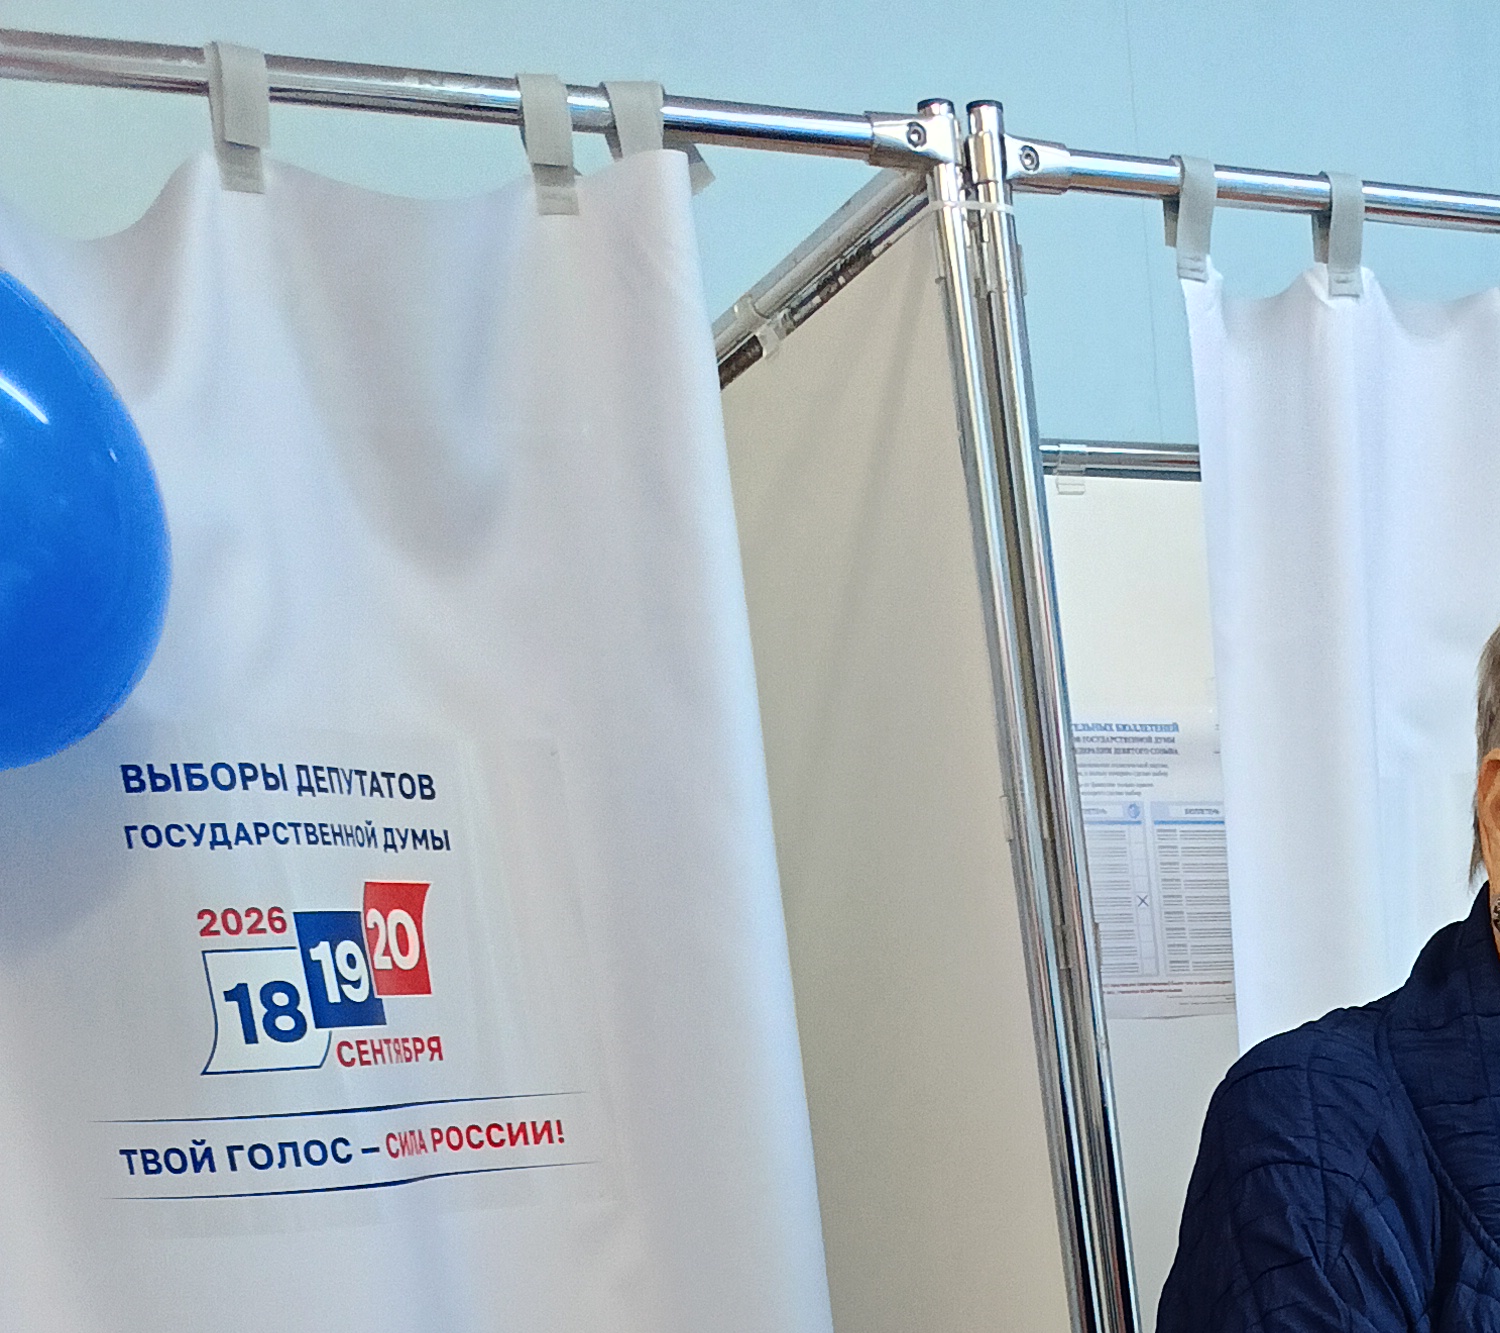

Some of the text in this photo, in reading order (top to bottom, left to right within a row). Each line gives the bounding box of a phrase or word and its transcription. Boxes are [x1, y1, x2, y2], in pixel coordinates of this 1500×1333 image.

[120, 762, 437, 800] ВЫБОРЫ ДЕПУТАТОВ
[123, 820, 452, 854] ГОСУДАРСТВЕННОЙ ДУМЫ
[197, 906, 288, 937] 2026
[366, 908, 420, 970] 20
[309, 940, 370, 1004] 19
[223, 980, 308, 1045] 18
[336, 1036, 444, 1068] СЕНТЯБРЯ
[119, 1138, 216, 1176] ТВОЙ
[227, 1136, 353, 1170] ГОЛОС
[385, 1128, 428, 1160] СИЛА
[431, 1119, 565, 1153] РОССИИ!
